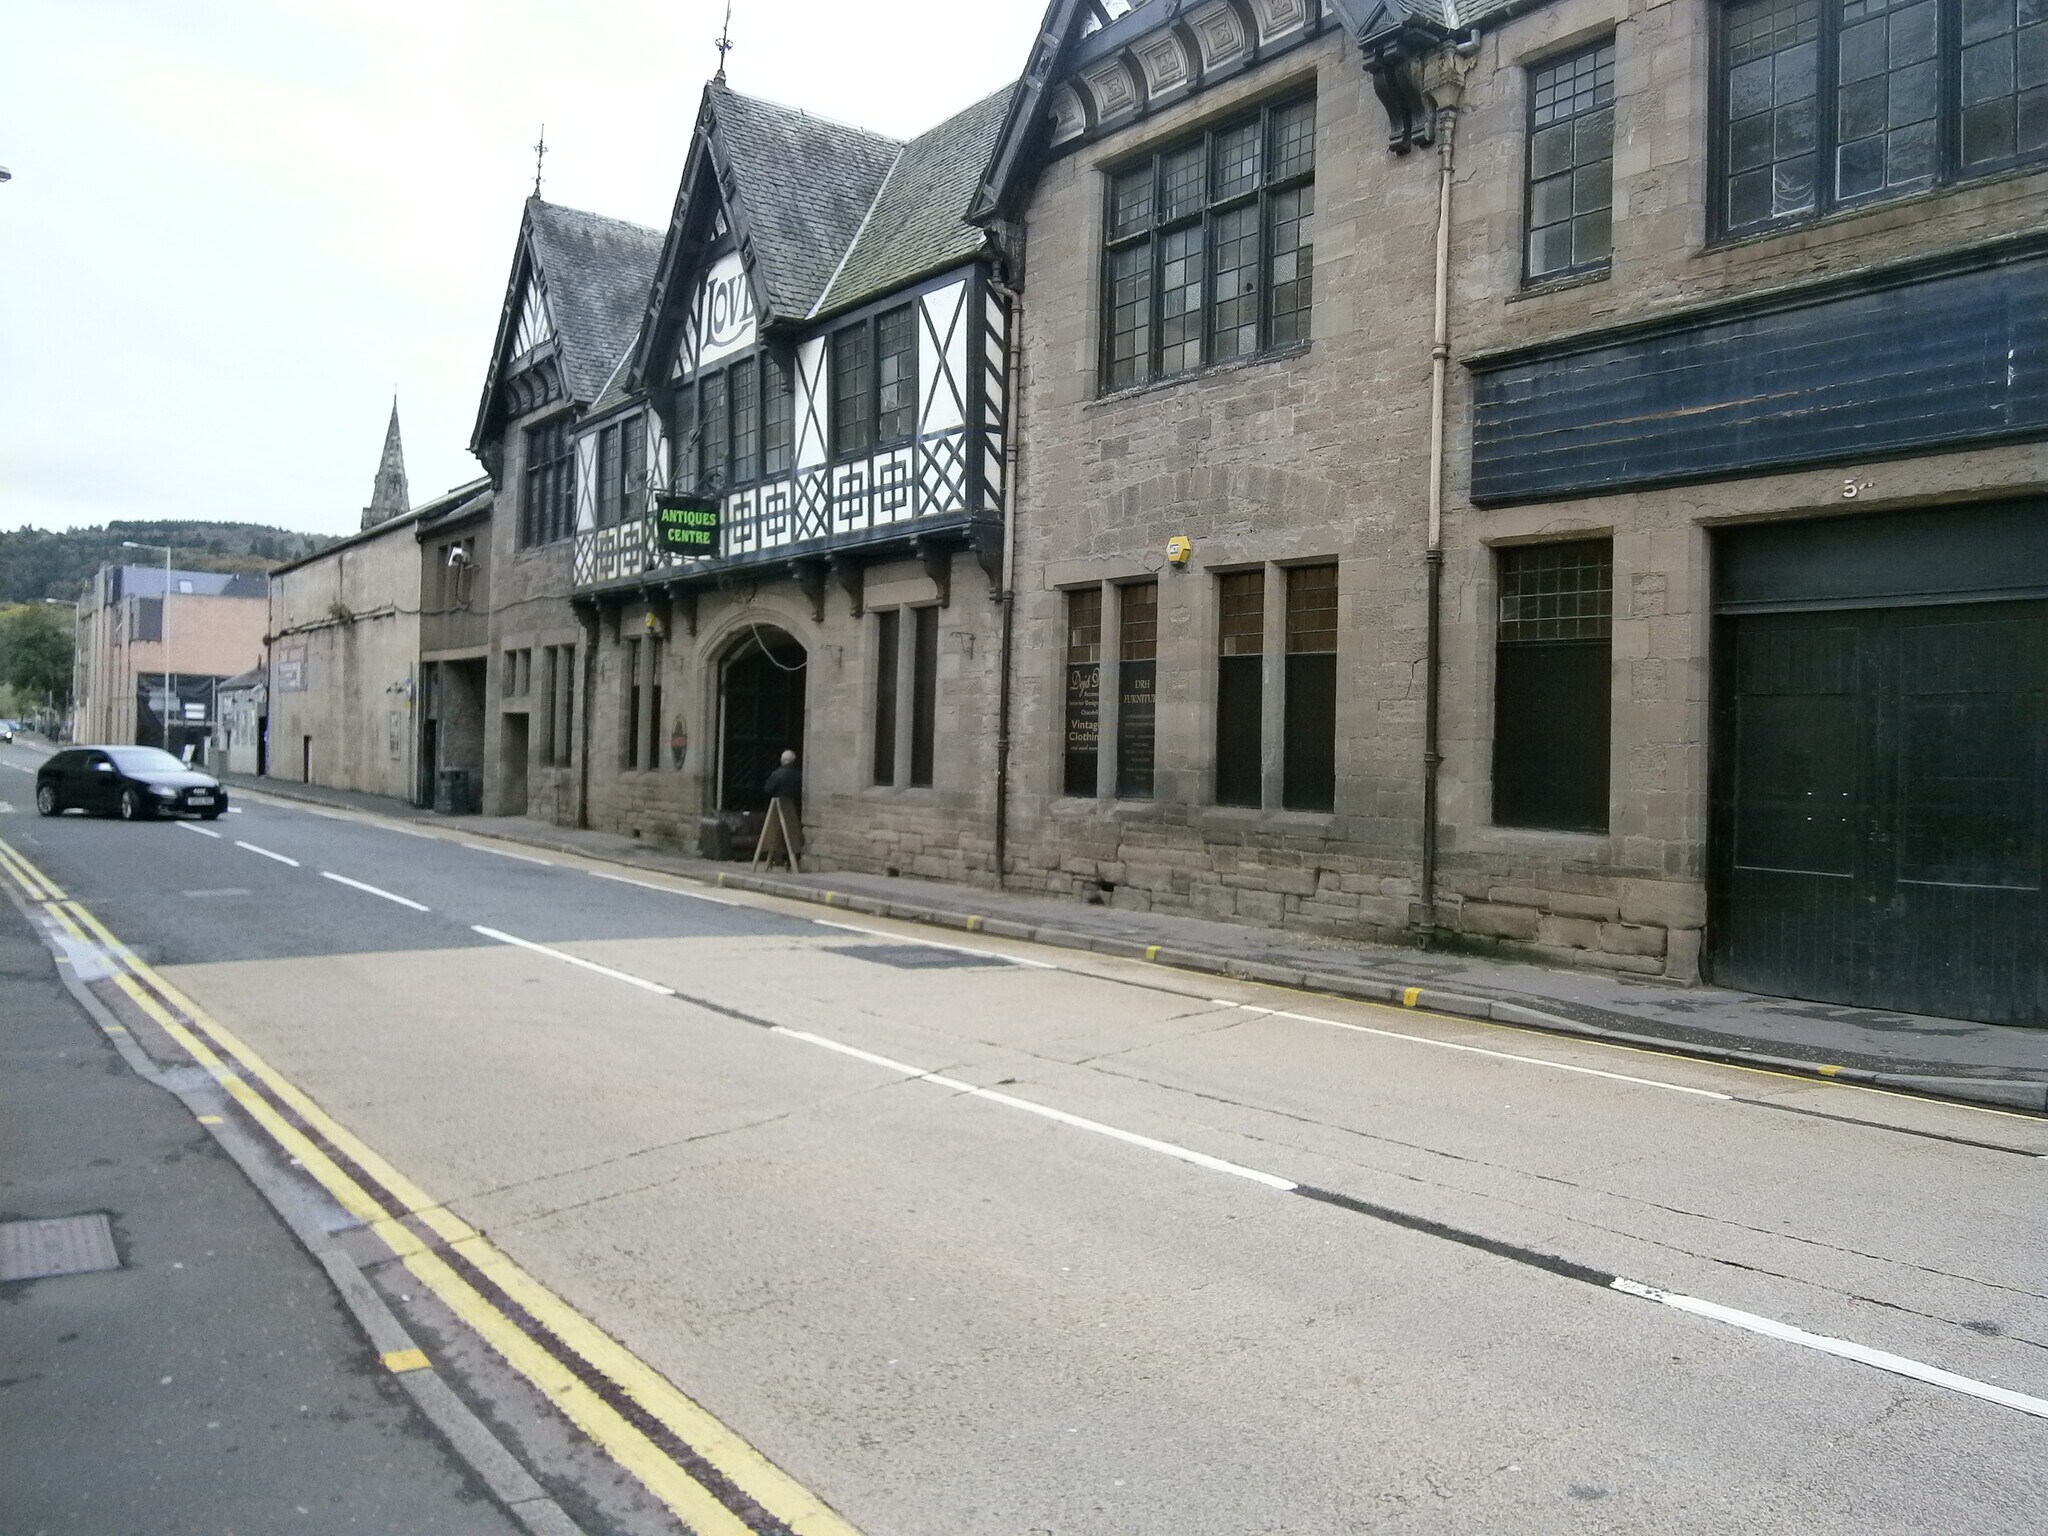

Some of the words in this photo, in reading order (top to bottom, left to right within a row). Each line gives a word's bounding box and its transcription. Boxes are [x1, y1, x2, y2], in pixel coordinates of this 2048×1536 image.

[661, 508, 717, 527] ANTIQUES
[667, 528, 711, 545] CENTRE
[1135, 679, 1150, 689] DRH
